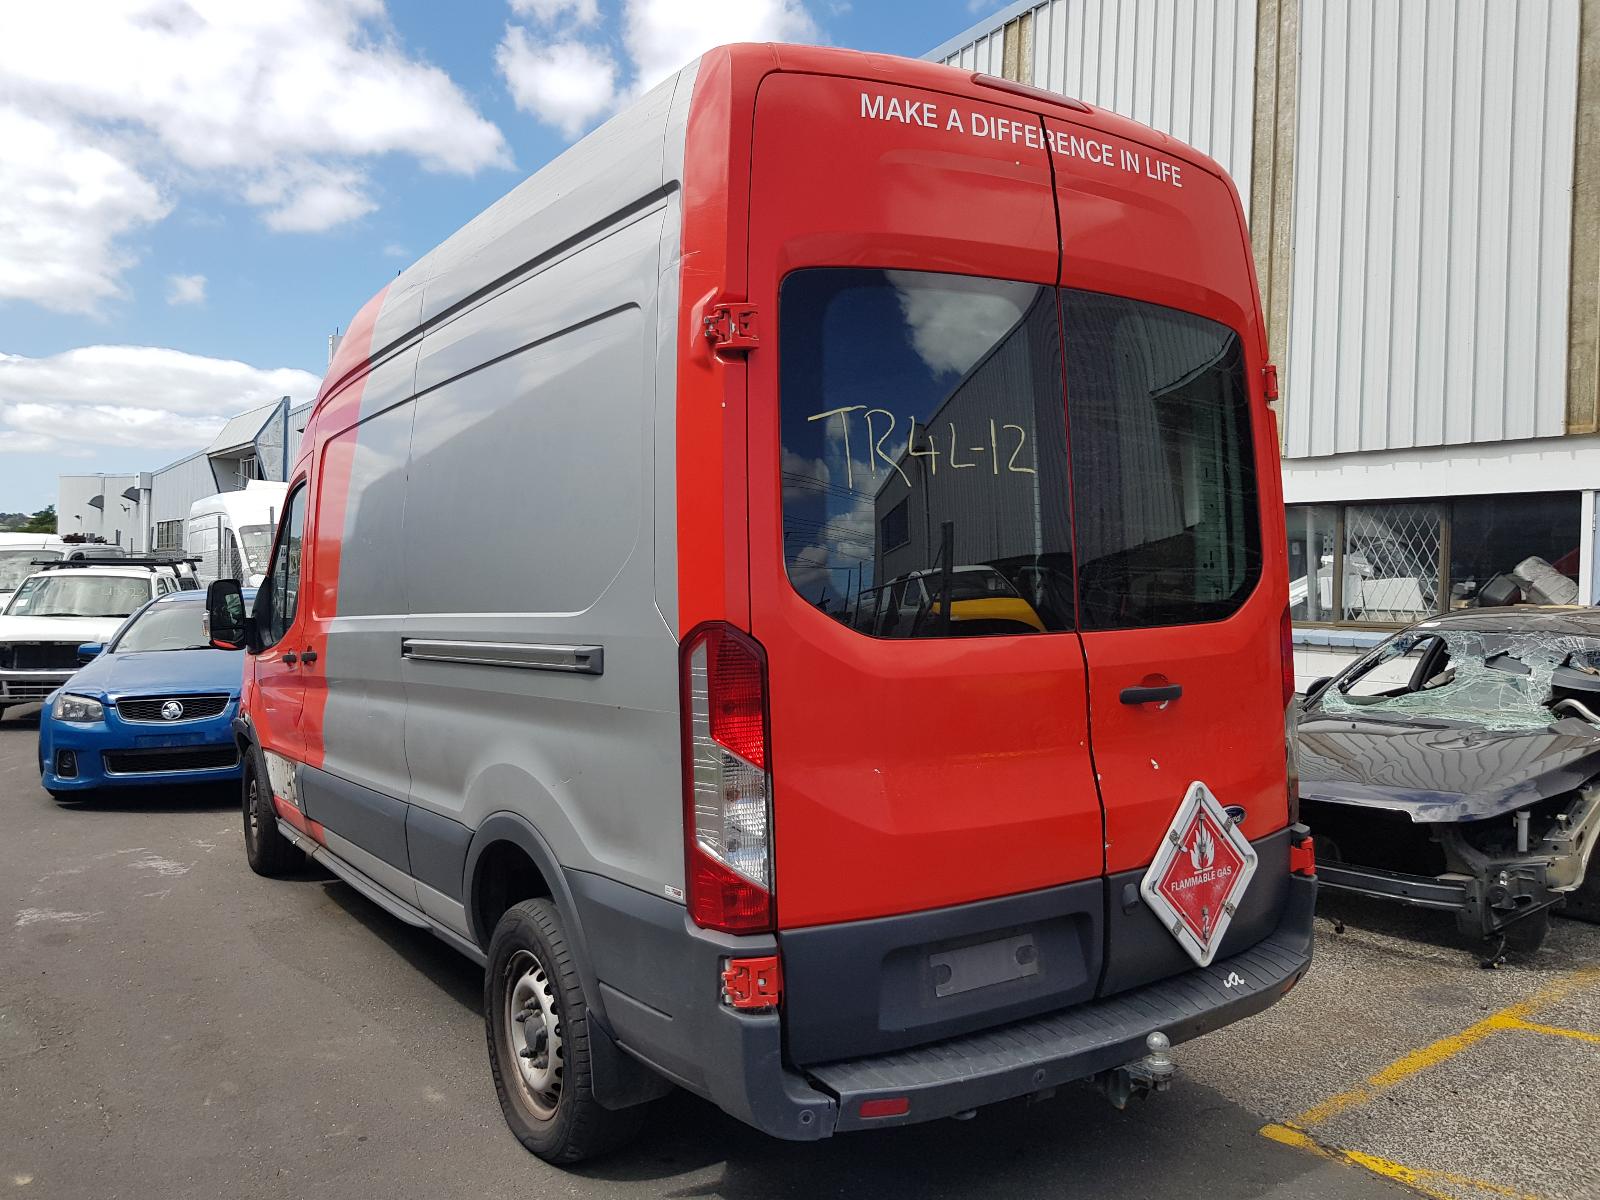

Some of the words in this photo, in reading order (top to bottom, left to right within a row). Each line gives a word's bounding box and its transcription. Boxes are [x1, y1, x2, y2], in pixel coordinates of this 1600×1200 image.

[860, 93, 938, 129] MAKE
[945, 108, 964, 132] A
[971, 112, 1115, 167] DIFFERENCE
[1119, 149, 1140, 174] IN
[1145, 156, 1183, 188] LIFE
[1171, 870, 1216, 891] FLAMMABLE
[1216, 865, 1232, 878] GAS
